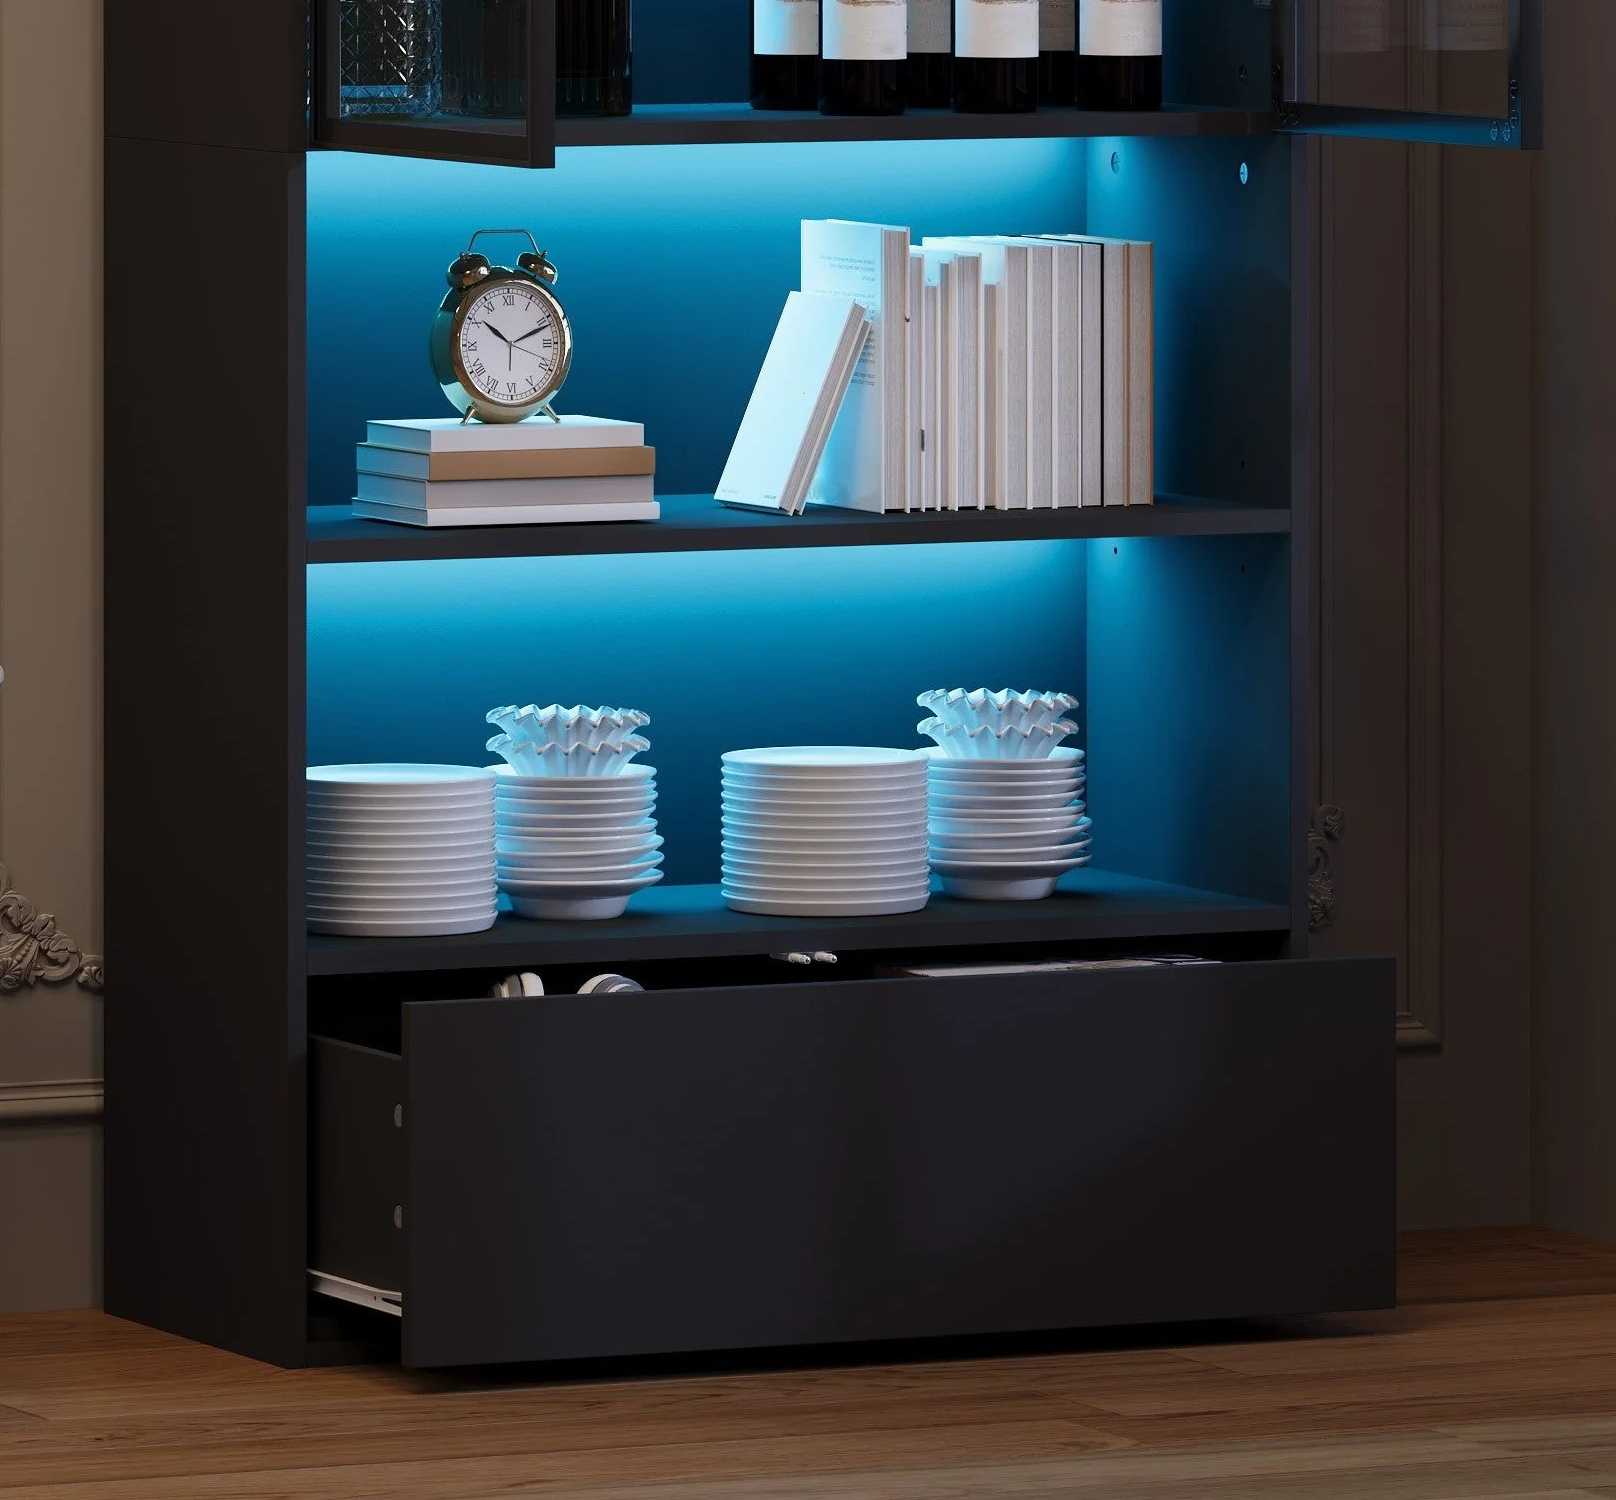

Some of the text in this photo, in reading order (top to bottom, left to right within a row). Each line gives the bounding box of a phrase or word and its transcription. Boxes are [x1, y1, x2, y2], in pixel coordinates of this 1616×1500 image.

[502, 295, 515, 306] XII
[524, 301, 532, 311] I
[483, 301, 495, 314] XI
[471, 318, 482, 329] X
[536, 317, 546, 326] II
[467, 340, 477, 351] IX
[542, 338, 552, 348] III
[472, 358, 486, 377] VIII
[538, 357, 550, 371] IV
[486, 375, 499, 391] VII
[525, 375, 534, 387] V
[506, 382, 517, 394] VI
